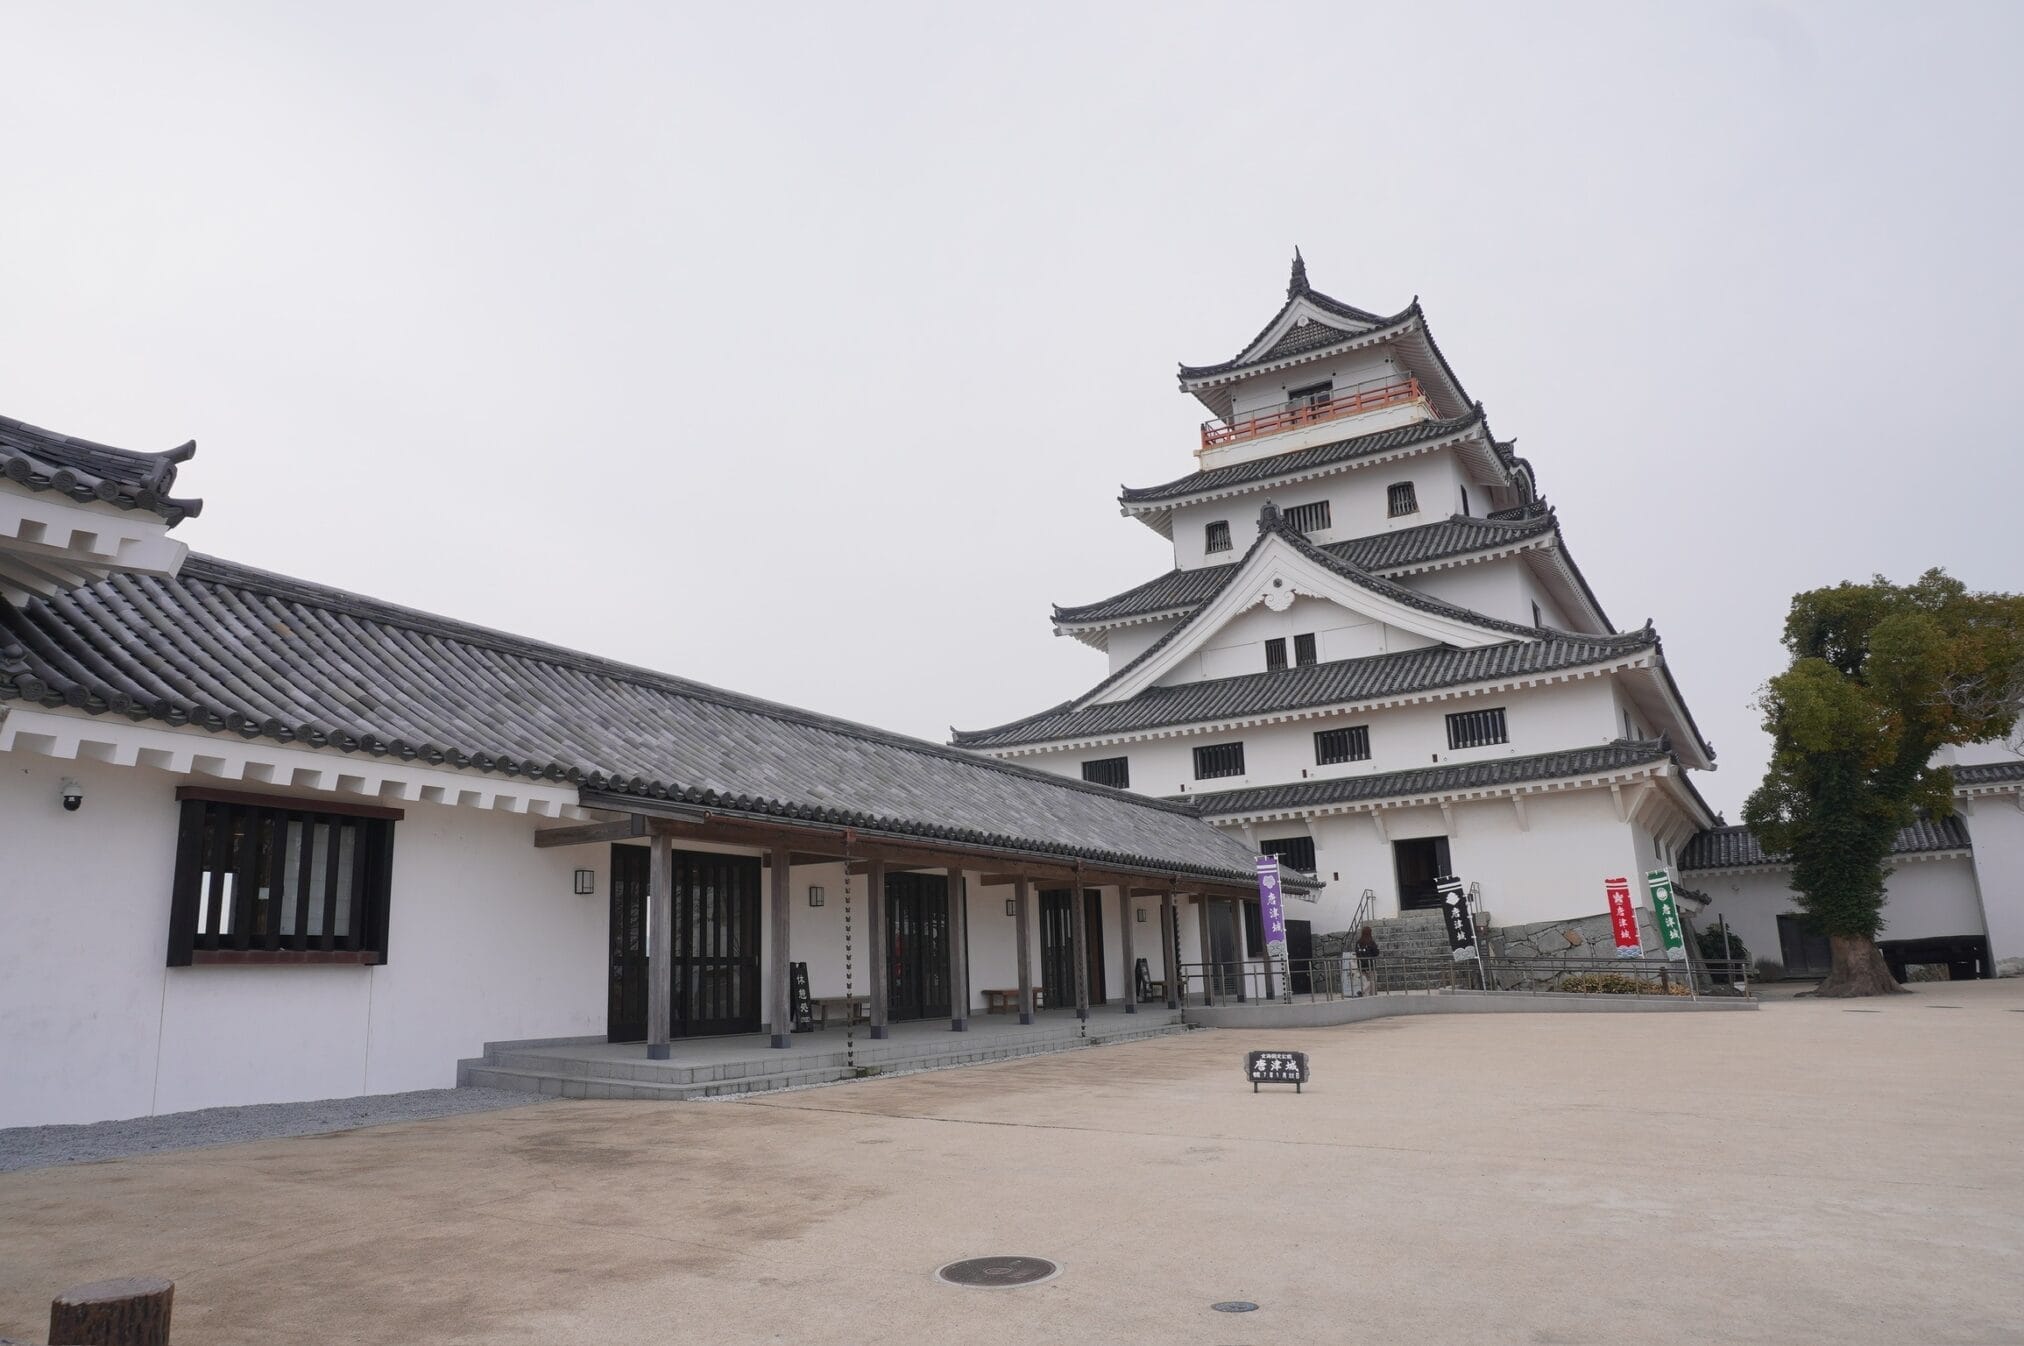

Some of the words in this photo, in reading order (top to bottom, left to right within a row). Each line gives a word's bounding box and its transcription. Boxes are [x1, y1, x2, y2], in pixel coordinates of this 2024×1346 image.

[1267, 892, 1282, 932] 唐津城
[1451, 907, 1466, 941] 唐津城
[1616, 906, 1631, 938] 唐津城
[1662, 903, 1680, 939] 唐津城
[1254, 1059, 1299, 1072] 唐津城
